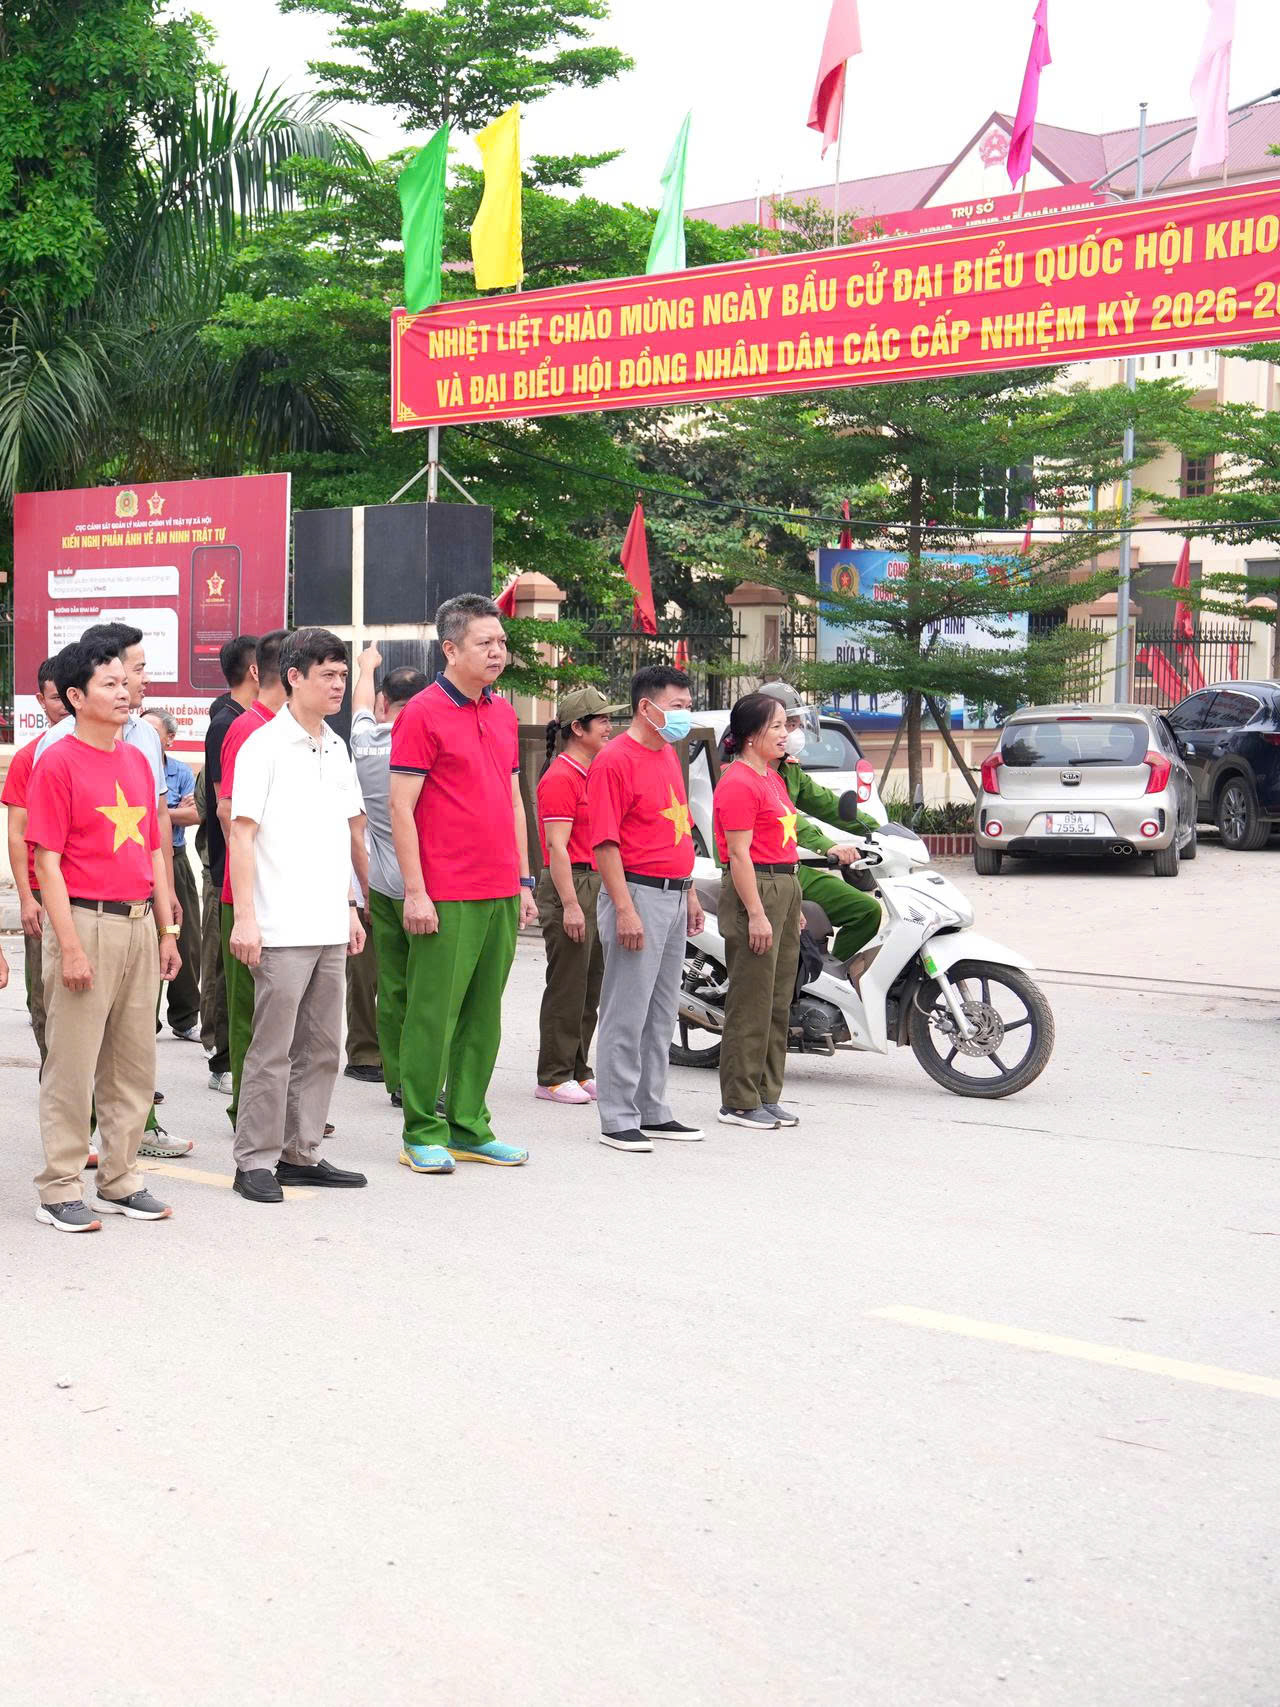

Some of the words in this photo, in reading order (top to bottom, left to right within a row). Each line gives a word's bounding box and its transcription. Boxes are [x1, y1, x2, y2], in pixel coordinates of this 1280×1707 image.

[951, 206, 974, 220] TRỤ
[976, 199, 995, 214] SỞ
[428, 320, 490, 362] NHIỆT
[497, 314, 541, 356] LIỆT
[549, 304, 612, 345] CHÀO
[620, 296, 694, 337] MỪNG
[702, 282, 773, 326] NGÀY
[782, 268, 837, 316] BẦU
[846, 260, 888, 307] CỬ
[892, 264, 943, 308] ĐẠI
[953, 240, 1023, 295] BIỂU
[1034, 227, 1124, 288] QUỐC
[1135, 221, 1193, 275] HỘI
[436, 372, 464, 409] VÀ
[470, 374, 507, 410] ĐẠI
[514, 356, 565, 401] BIỂU
[572, 356, 612, 400] HỘI
[619, 346, 687, 390] ĐỒNG
[695, 338, 769, 383] NHÂN
[777, 331, 834, 373] DÂN
[843, 322, 901, 366] CÁC
[910, 308, 971, 359] CẤP
[980, 301, 1086, 353] NHIỆM
[1097, 291, 1142, 338] KỲ
[1150, 281, 1280, 331] 2026-2
[62, 532, 80, 549] KIẾN
[81, 535, 100, 550] NGHỊ
[102, 529, 124, 547] PHẢN
[125, 530, 142, 546] ÁNH
[156, 531, 168, 544] AN
[169, 529, 190, 544] NINH
[192, 527, 213, 544] TRẬT
[214, 527, 227, 544] TỰ
[903, 916, 925, 927] HONDA
